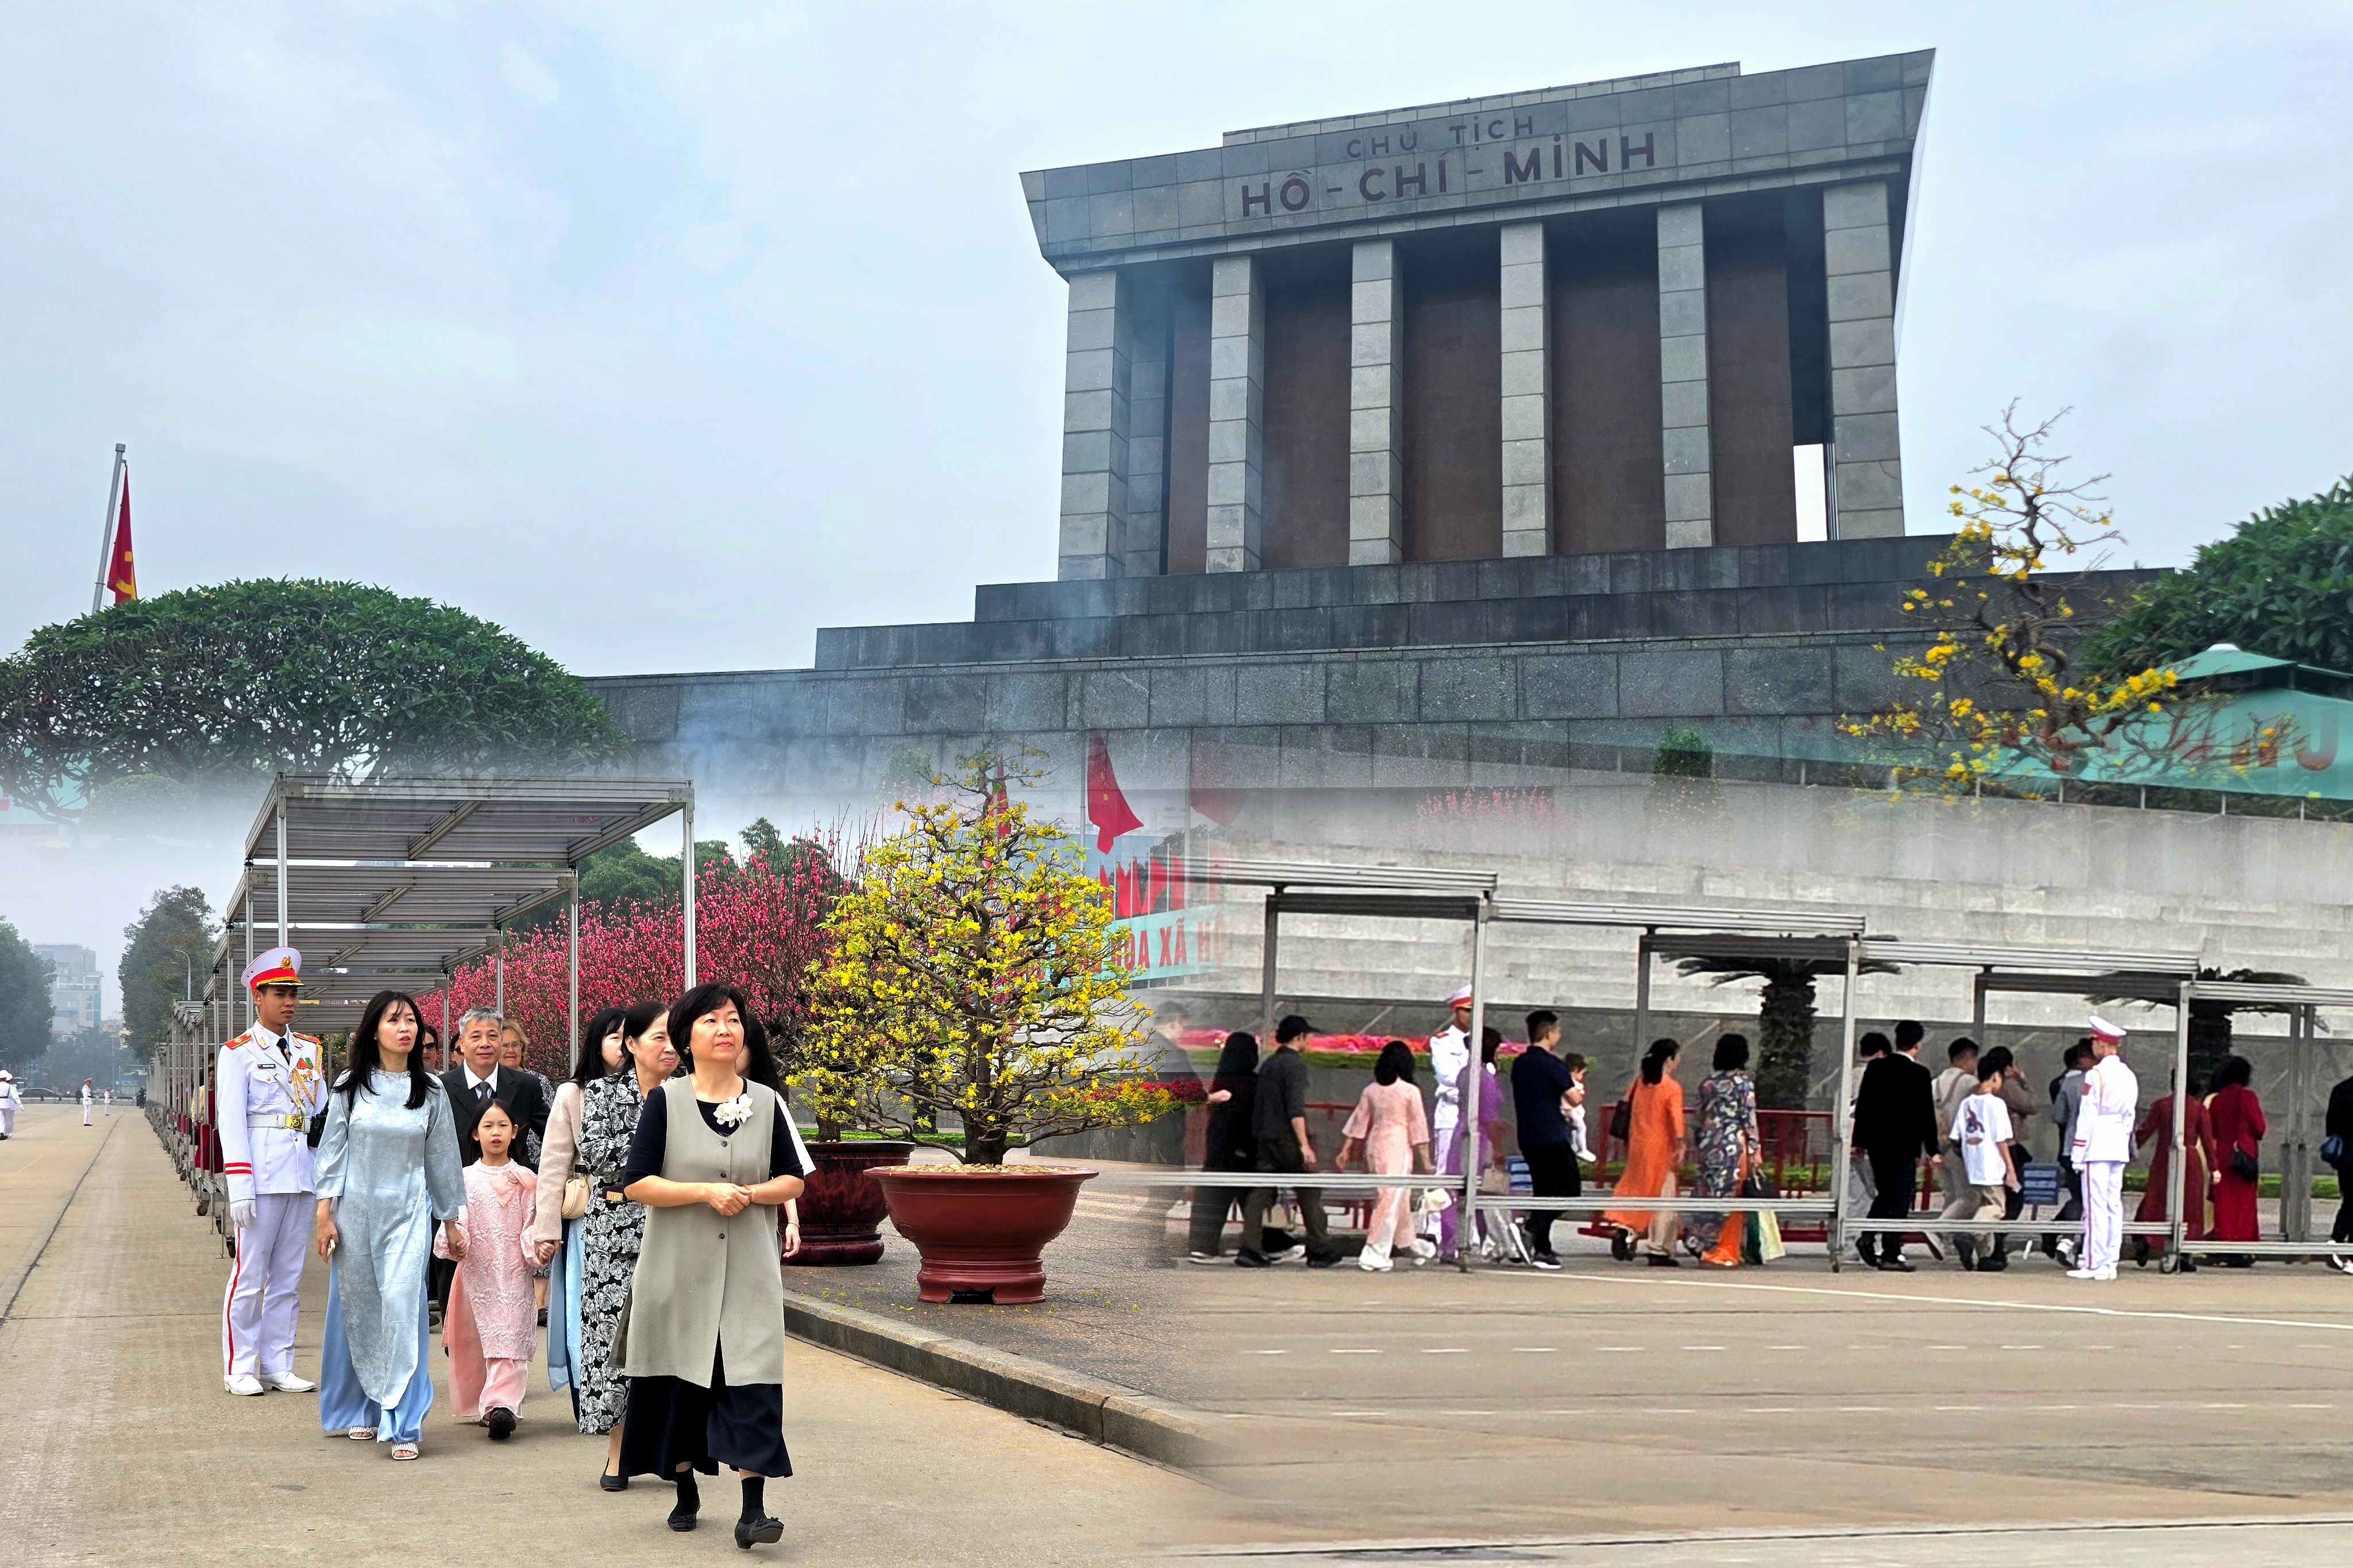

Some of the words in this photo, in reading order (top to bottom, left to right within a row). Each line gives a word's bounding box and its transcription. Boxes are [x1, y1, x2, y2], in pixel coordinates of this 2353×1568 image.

[1347, 123, 1418, 158] CHỦ
[1359, 150, 1451, 202] CHÍ
[1504, 132, 1654, 184] MINH
[1159, 916, 1187, 968] XÃ
